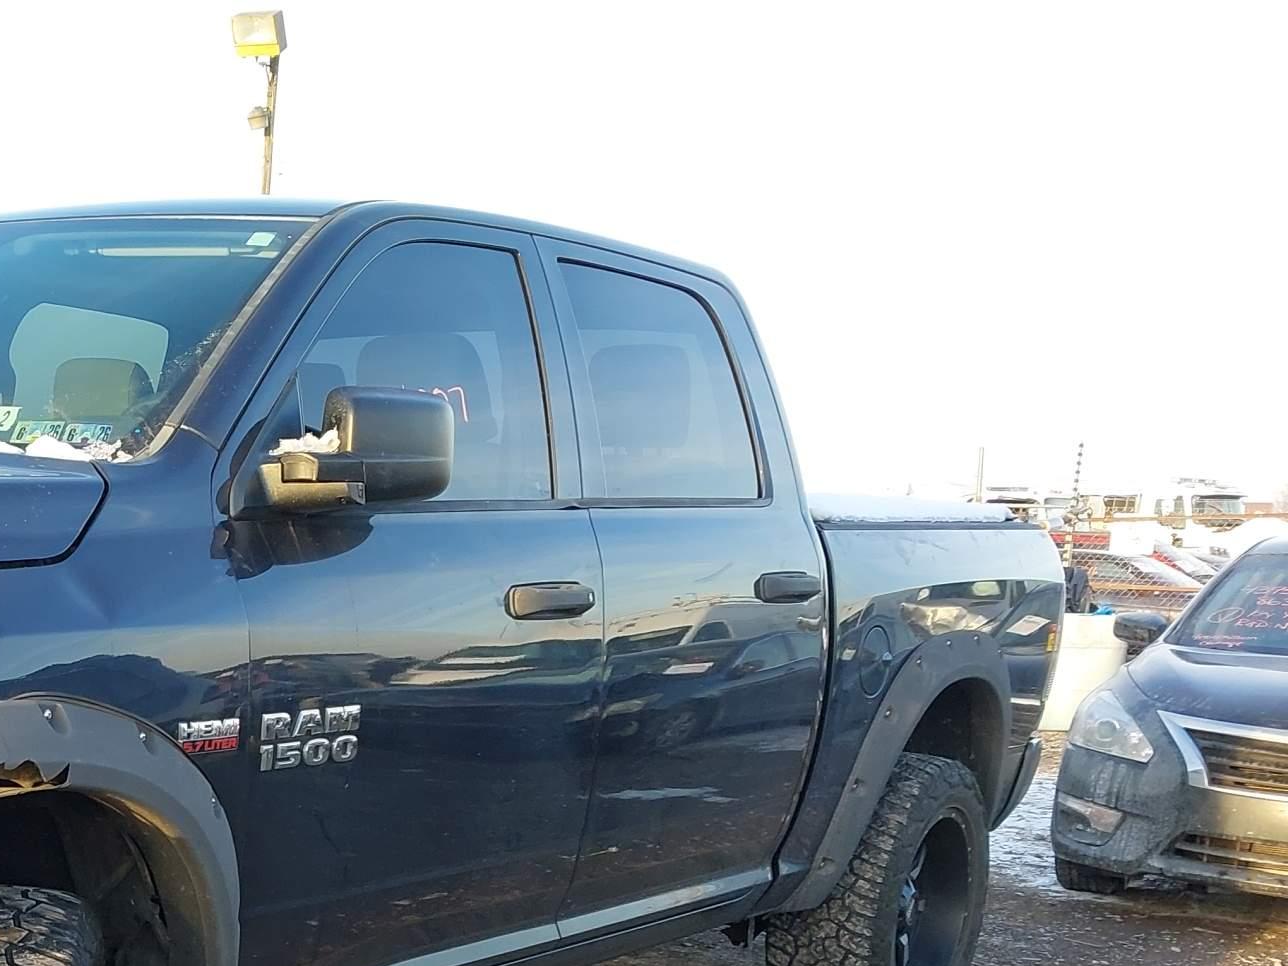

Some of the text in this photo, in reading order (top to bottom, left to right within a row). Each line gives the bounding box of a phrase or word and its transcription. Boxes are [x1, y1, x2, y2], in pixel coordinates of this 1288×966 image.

[16, 427, 26, 440] 6
[67, 428, 77, 441] 6
[178, 718, 240, 741] HEMI
[262, 705, 361, 740] RAM
[204, 737, 238, 751] LITER
[260, 735, 358, 771] 1500
